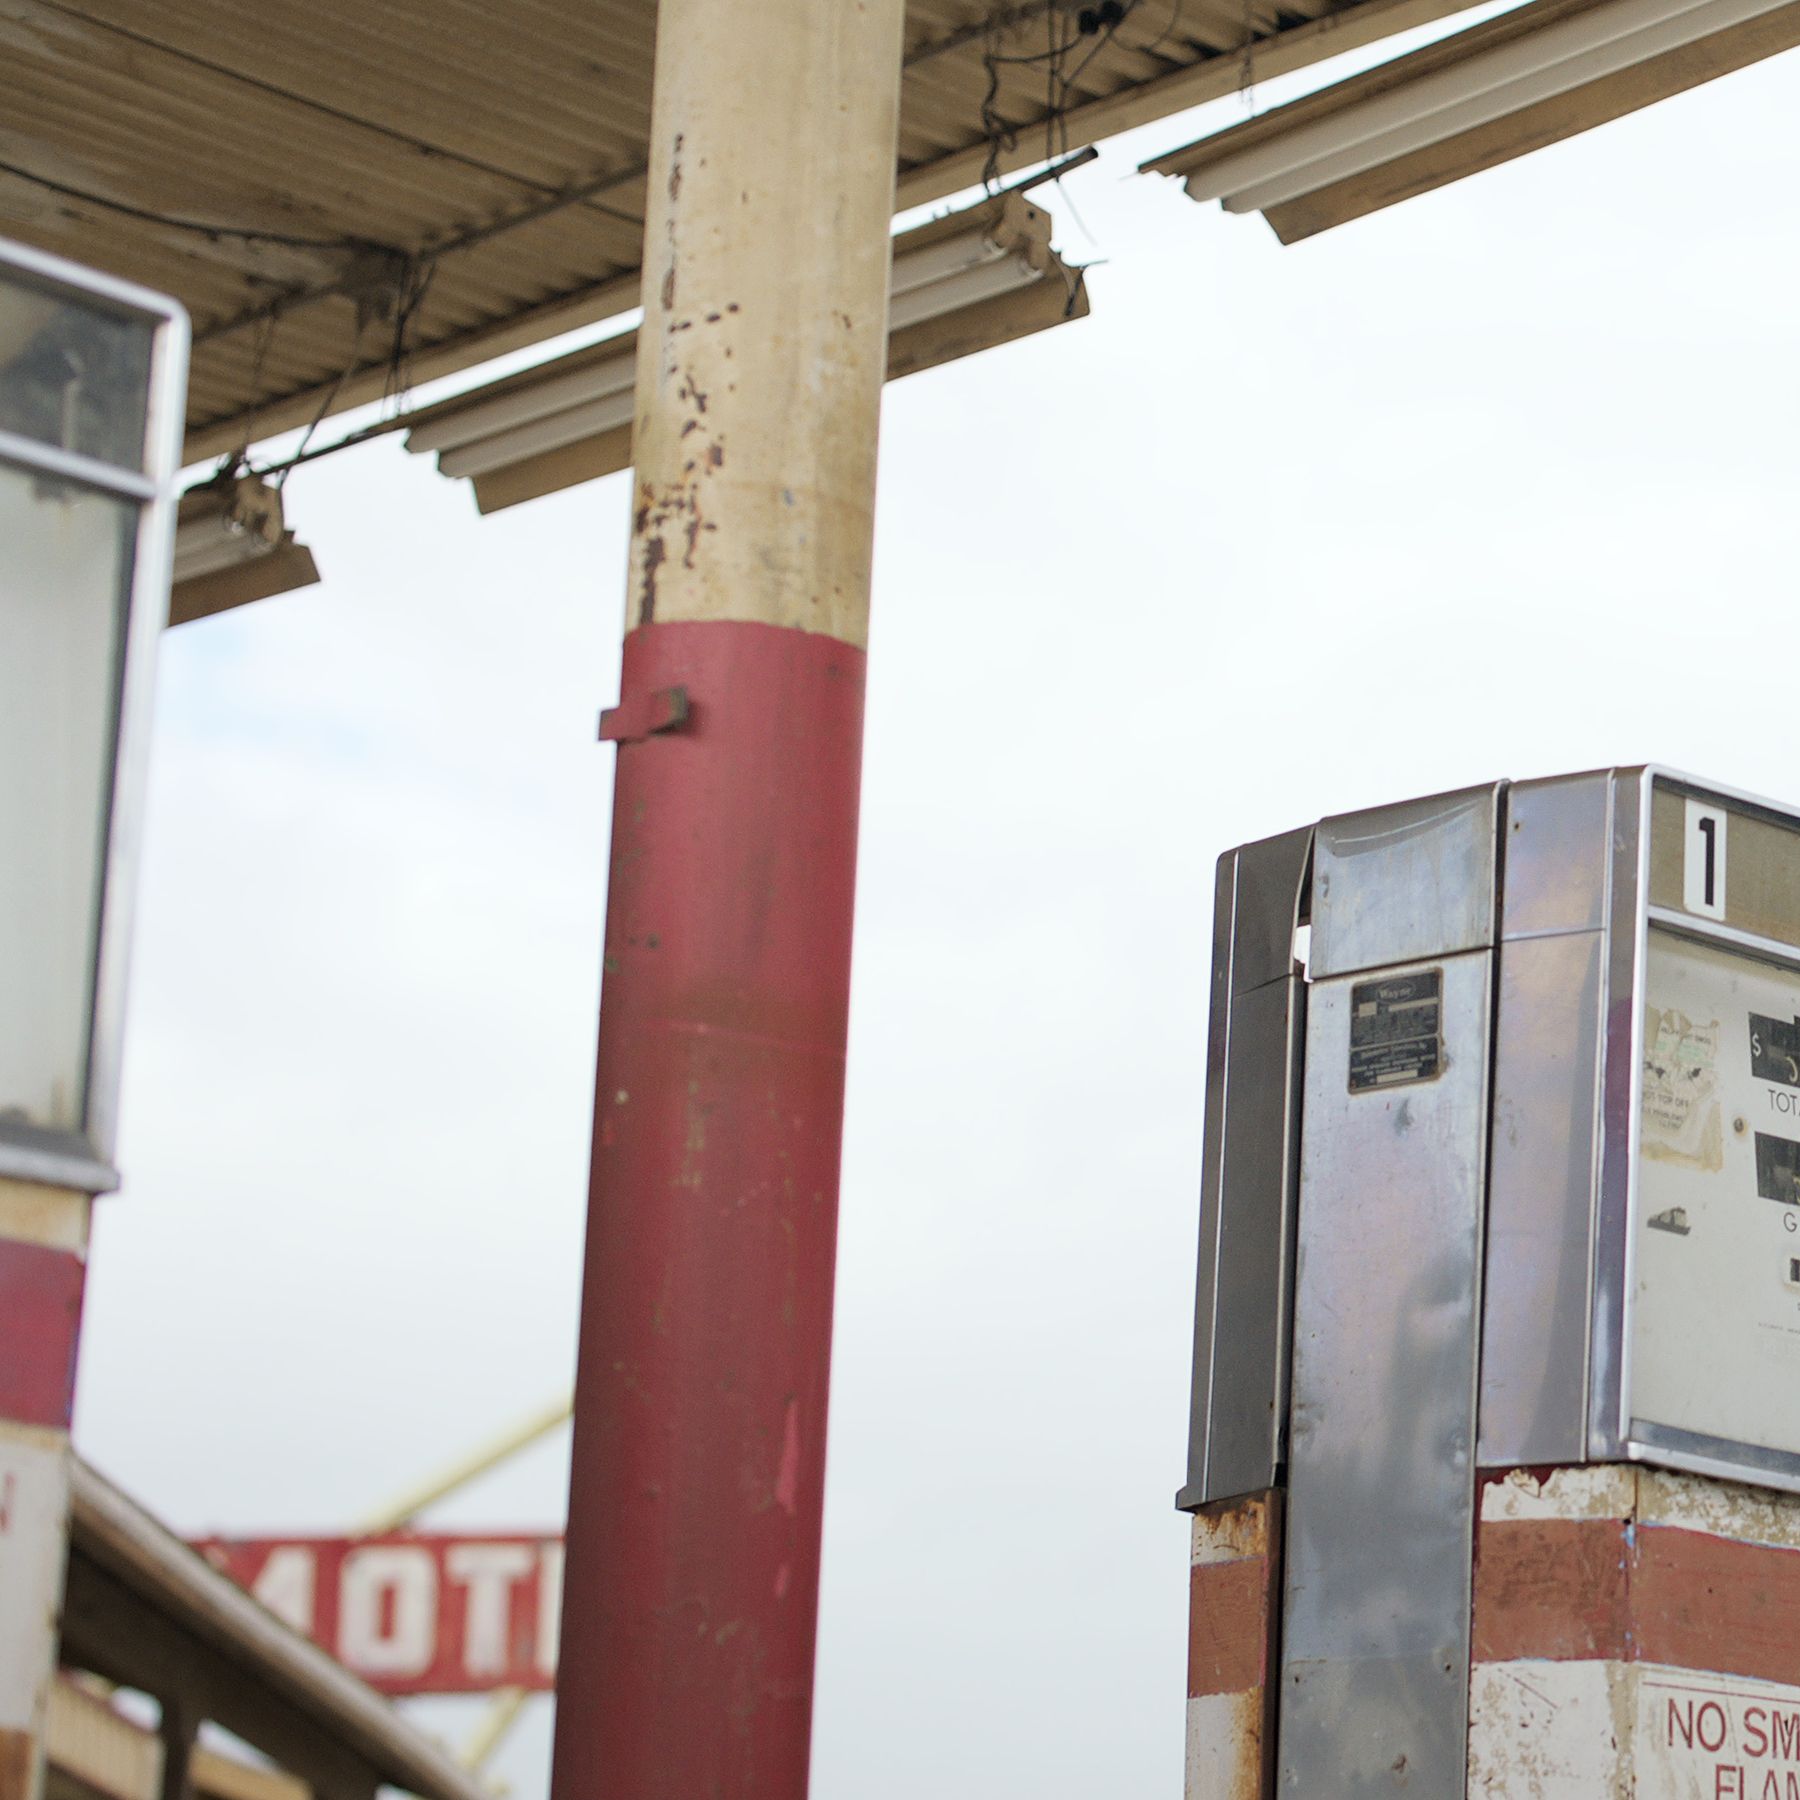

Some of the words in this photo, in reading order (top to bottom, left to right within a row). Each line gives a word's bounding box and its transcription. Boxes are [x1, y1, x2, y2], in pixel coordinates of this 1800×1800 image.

[1699, 816, 1715, 906] 1
[1752, 1033, 1762, 1057] $
[1667, 1698, 1727, 1752] NO
